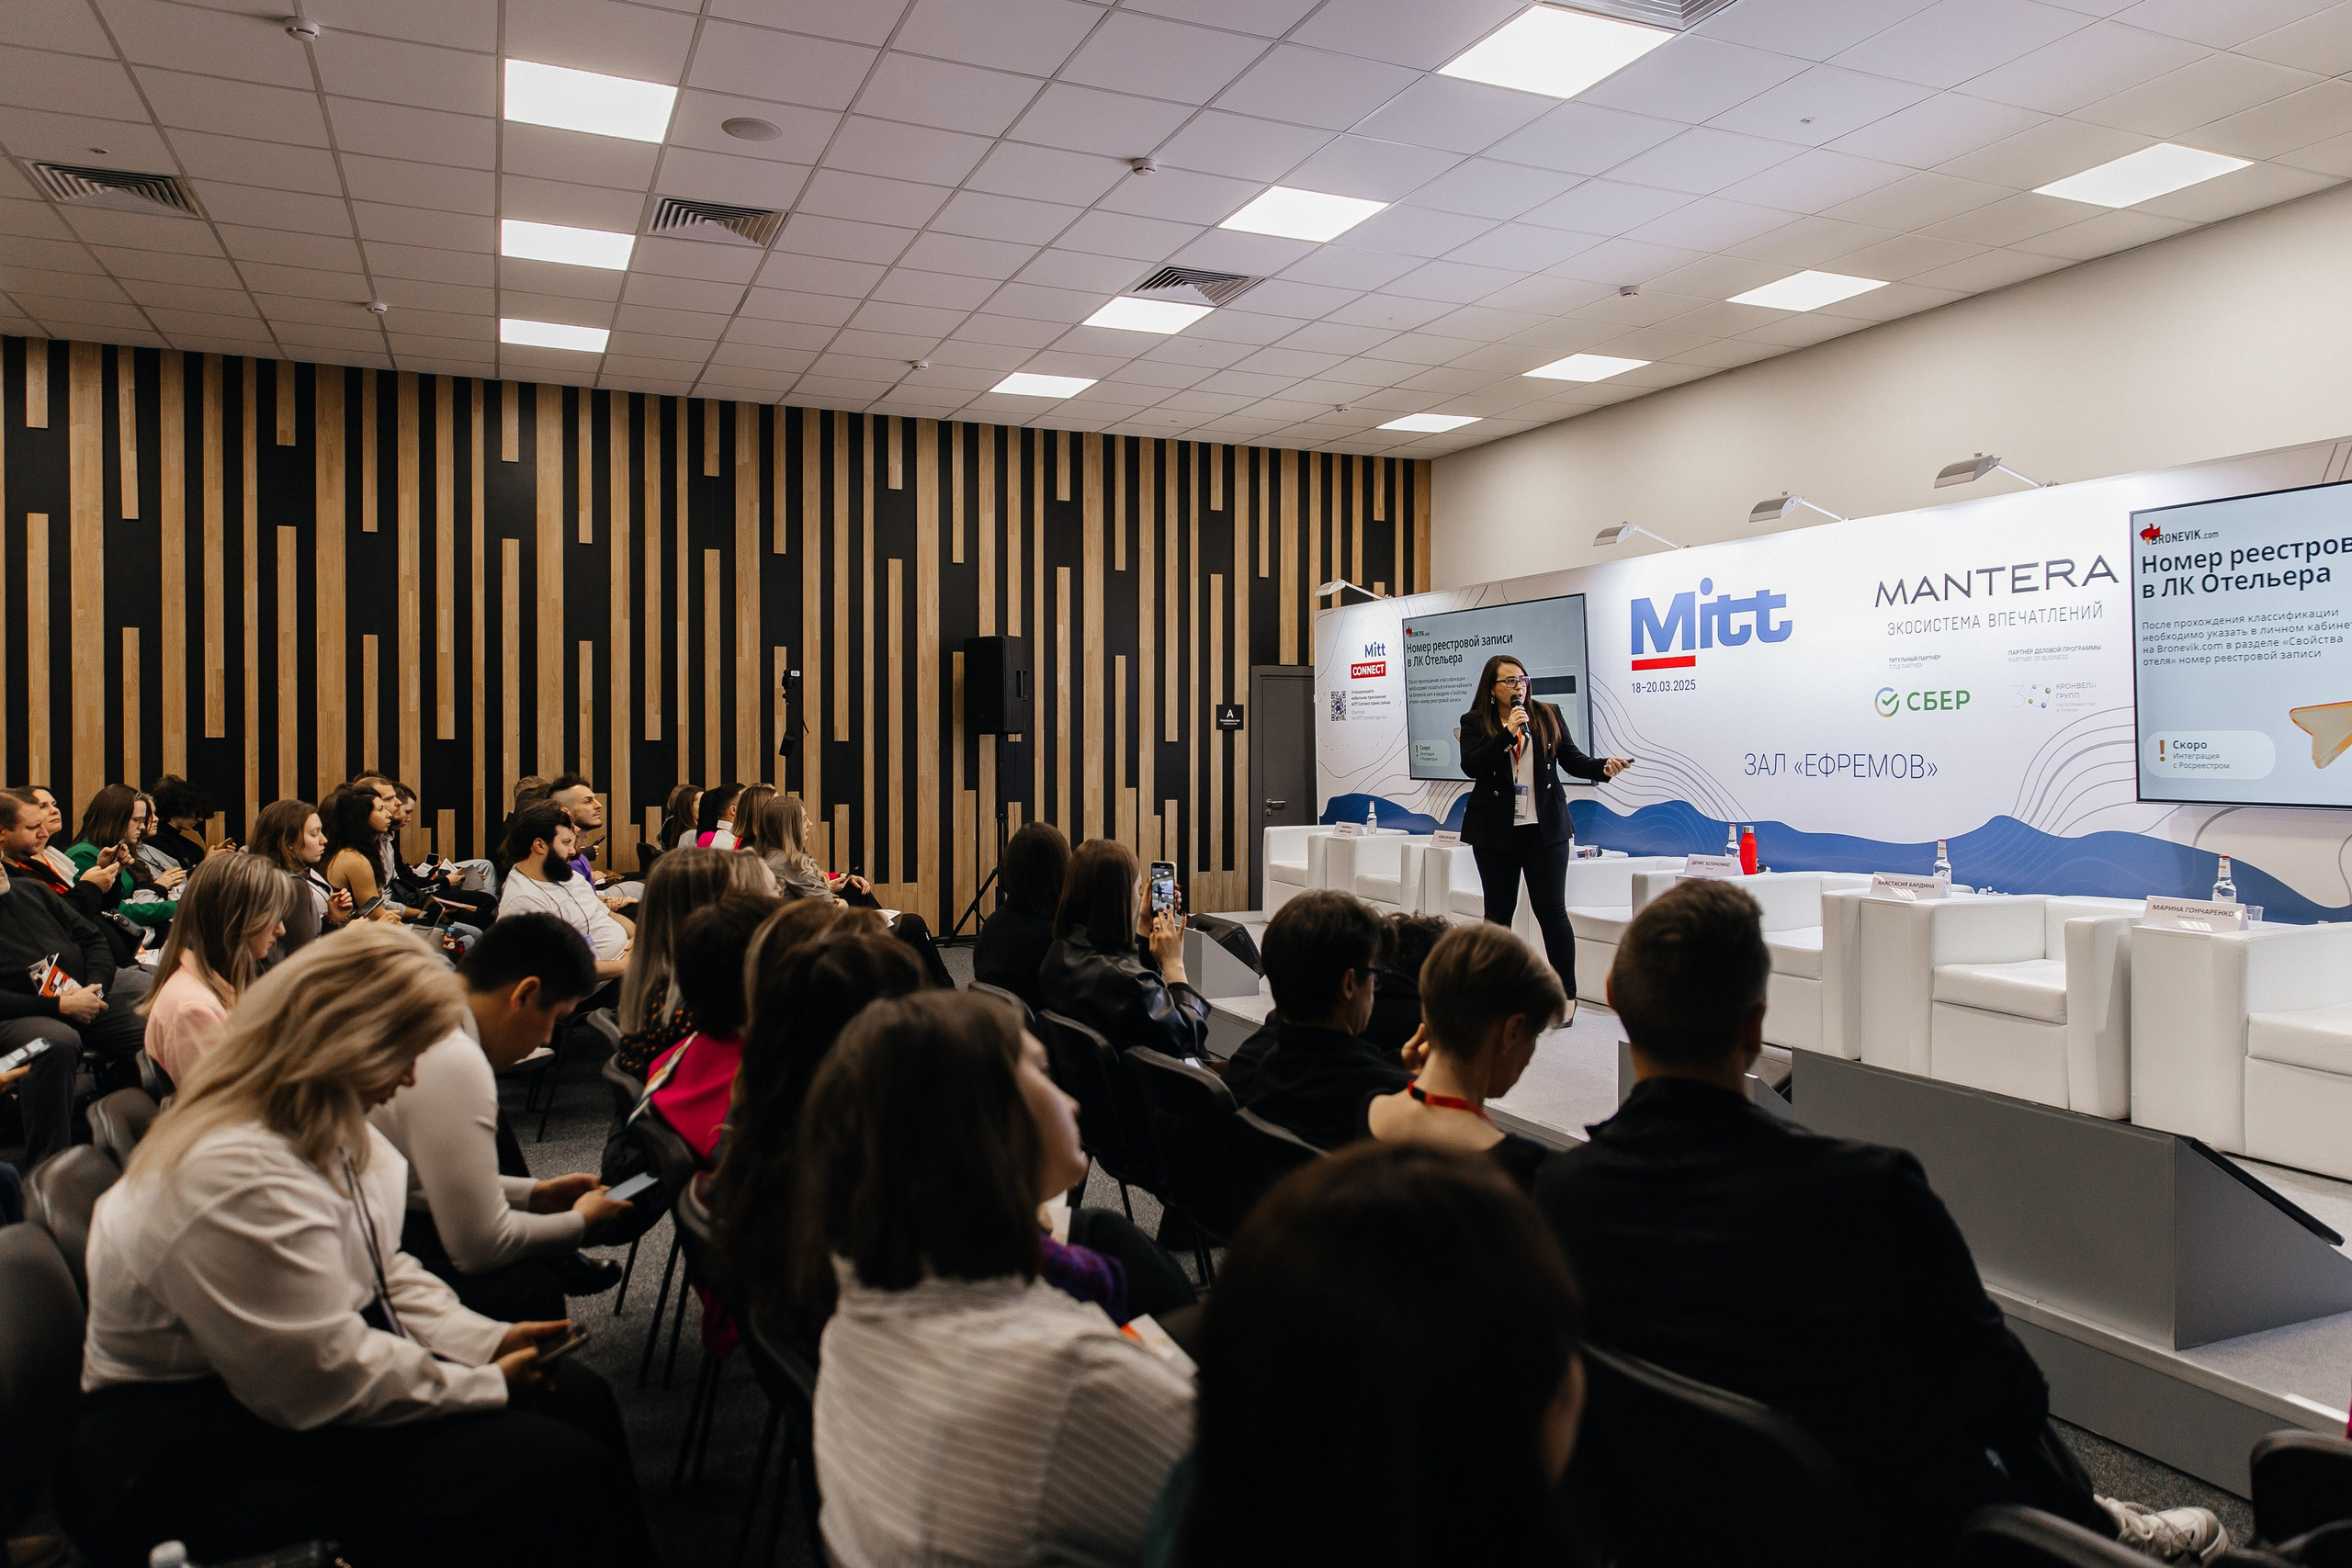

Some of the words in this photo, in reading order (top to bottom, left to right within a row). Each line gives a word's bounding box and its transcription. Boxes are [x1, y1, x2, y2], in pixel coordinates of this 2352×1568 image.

[2142, 550, 2222, 575] Номер
[1875, 554, 2120, 607] MANTERA
[2143, 583, 2155, 598] в
[2161, 576, 2195, 597] ЛК
[2201, 566, 2331, 591] Отельера
[1631, 577, 1792, 655] Mitt
[1888, 615, 1981, 636] ЭКОСИСТЕМА
[1988, 601, 2103, 627] ВПЕЧАТЛЕНИЙ
[2143, 621, 2171, 630] После
[2174, 616, 2245, 629] прохождения
[2248, 609, 2339, 623] классификации
[2143, 631, 2204, 642] необходимо
[2207, 629, 2247, 640] указать
[2260, 626, 2304, 635] личном
[1364, 641, 1385, 658] Mitt
[1407, 642, 1431, 654] Номер
[1433, 634, 1480, 654] реестровой
[1481, 634, 1513, 646] записи
[2034, 646, 2062, 655] ДЕЛОВОЙ
[2157, 642, 2222, 653] Bronevik.com
[2235, 639, 2279, 650] разделе
[2283, 635, 2343, 646] «Свойства
[1408, 659, 1412, 667] в
[1413, 655, 1424, 667] ЛК
[1425, 653, 1463, 666] Отельера
[2143, 658, 2176, 666] отеля»
[2178, 655, 2211, 665] номер
[2214, 650, 2277, 664] реестровой
[2280, 649, 2322, 660] записи
[1352, 663, 1385, 676] CONNECT
[1907, 689, 1971, 711] СБЕР
[2173, 740, 2208, 751] Скоро
[1745, 753, 1786, 775] ЗАЛ
[1794, 752, 1938, 779] «ЕФРЕМОВ»
[2178, 762, 2230, 771] Росреестром
[2153, 904, 2184, 912] МАРИНА
[2185, 907, 2234, 917] ГОНЧАРЕНКО
